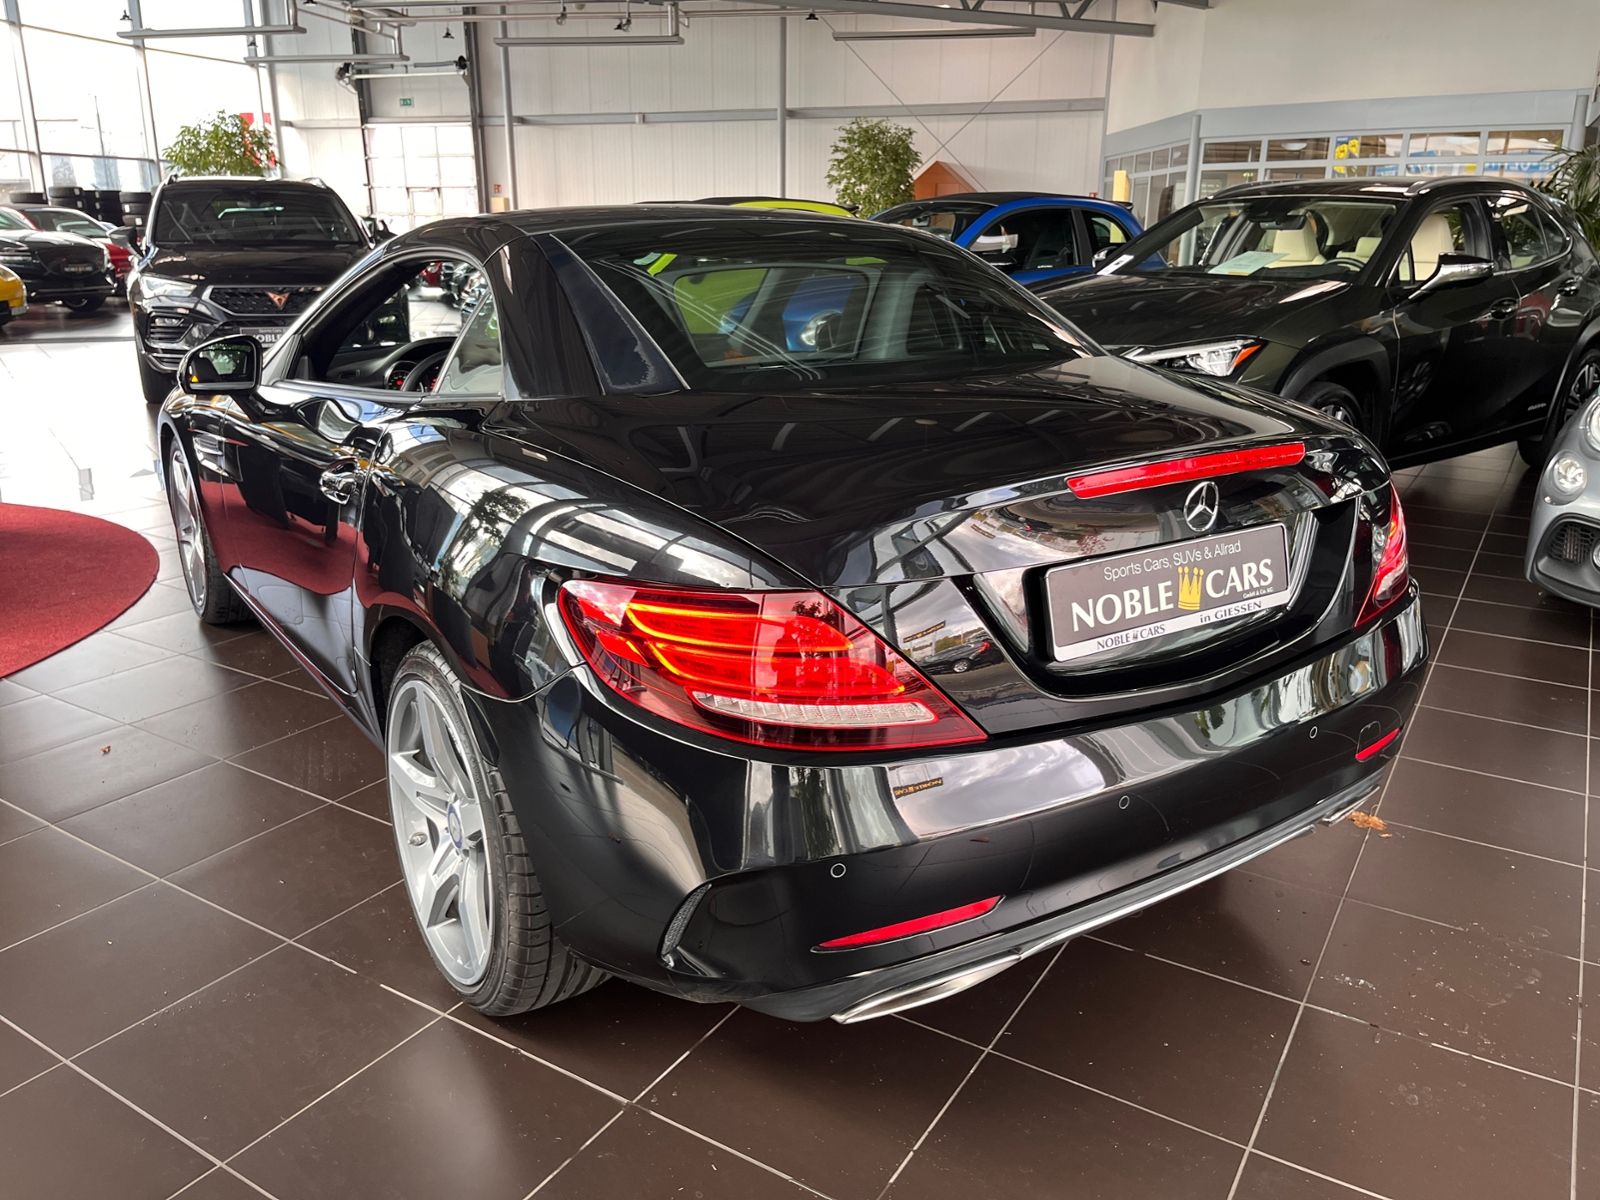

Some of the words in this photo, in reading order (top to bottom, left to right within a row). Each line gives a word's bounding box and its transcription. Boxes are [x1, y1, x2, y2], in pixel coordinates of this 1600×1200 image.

[1103, 561, 1142, 582] Sports
[1143, 556, 1173, 574] Cars,
[1173, 547, 1202, 566] SUVs
[1203, 546, 1213, 560] &
[1213, 540, 1242, 558] Allrad
[1071, 581, 1174, 632] NOBLE
[1205, 558, 1273, 599] CARS
[1200, 613, 1212, 624] in
[1214, 600, 1263, 620] GIESSEN
[1096, 633, 1132, 651] NOBLE
[1139, 624, 1166, 640] CARS
